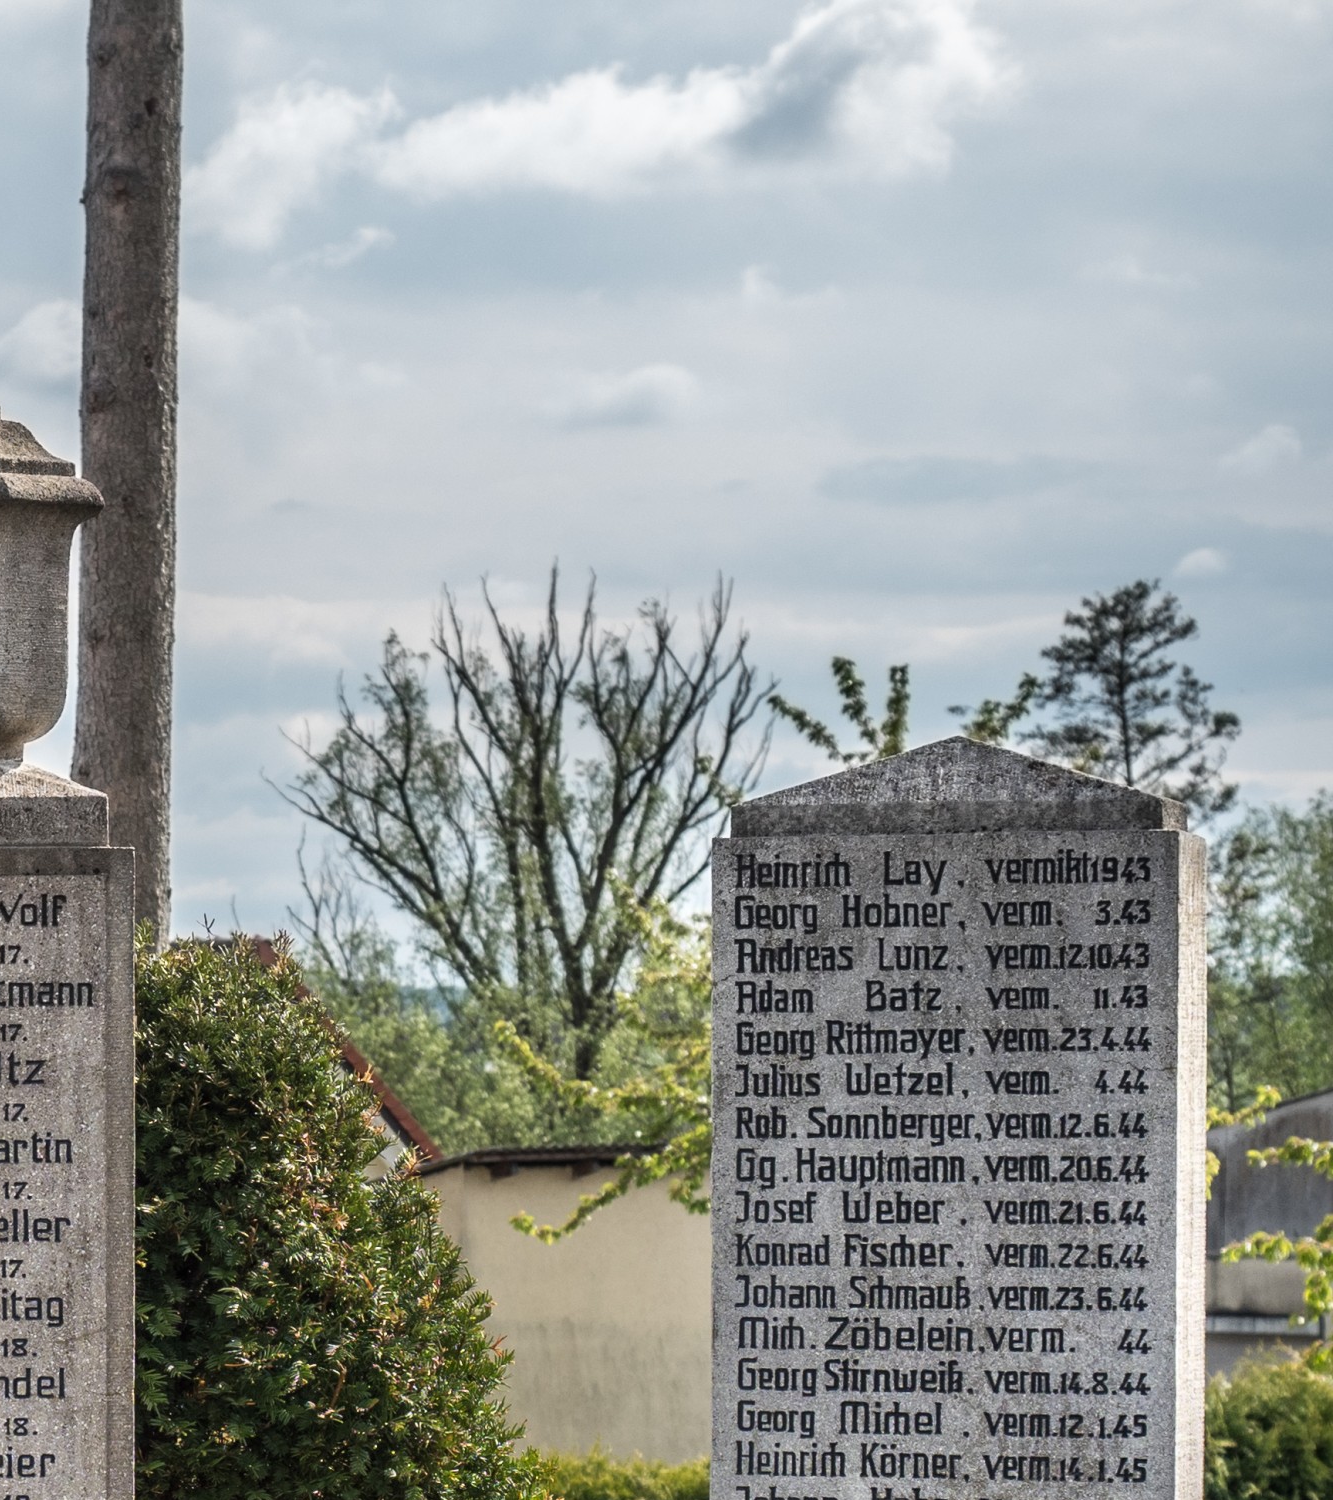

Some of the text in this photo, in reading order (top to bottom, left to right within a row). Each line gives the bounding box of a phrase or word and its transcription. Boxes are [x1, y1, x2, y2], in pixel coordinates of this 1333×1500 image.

[734, 895, 818, 934] Georg
[734, 939, 853, 974] Andreas
[736, 980, 813, 1014] Adam
[736, 1022, 814, 1061] Georg
[736, 1064, 820, 1098] Julius
[736, 1190, 817, 1223] Josef
[735, 1233, 829, 1267] Konrad
[735, 1274, 836, 1308] Johann
[738, 1358, 817, 1396] Georg
[737, 1400, 814, 1438] Georg
